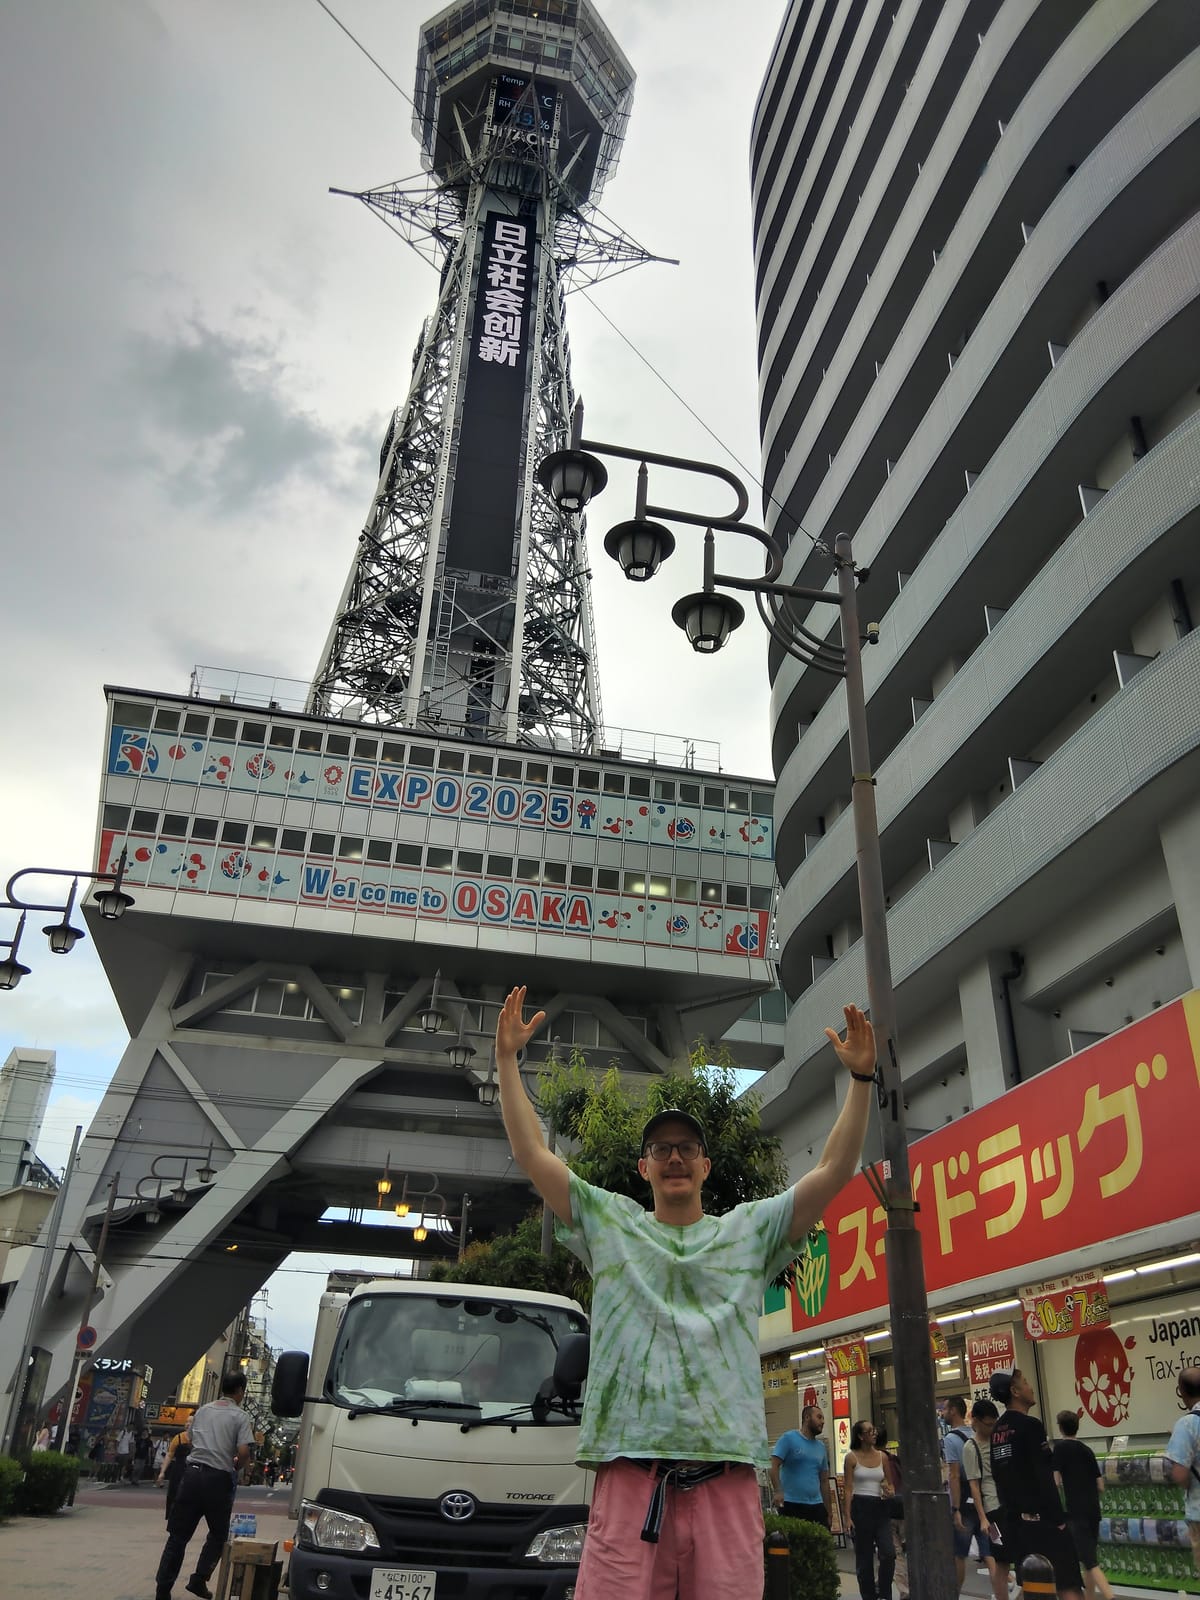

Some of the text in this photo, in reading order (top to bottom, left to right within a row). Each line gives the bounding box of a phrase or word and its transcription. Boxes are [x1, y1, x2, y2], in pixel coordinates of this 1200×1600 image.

[501, 75, 524, 86] Temp
[499, 100, 511, 108] RH
[478, 220, 527, 367] 日立社会创新
[304, 866, 589, 926] Welcome to OSAKA
[972, 1338, 1009, 1356] Duty-free
[374, 1584, 432, 1600] せ 45-67
